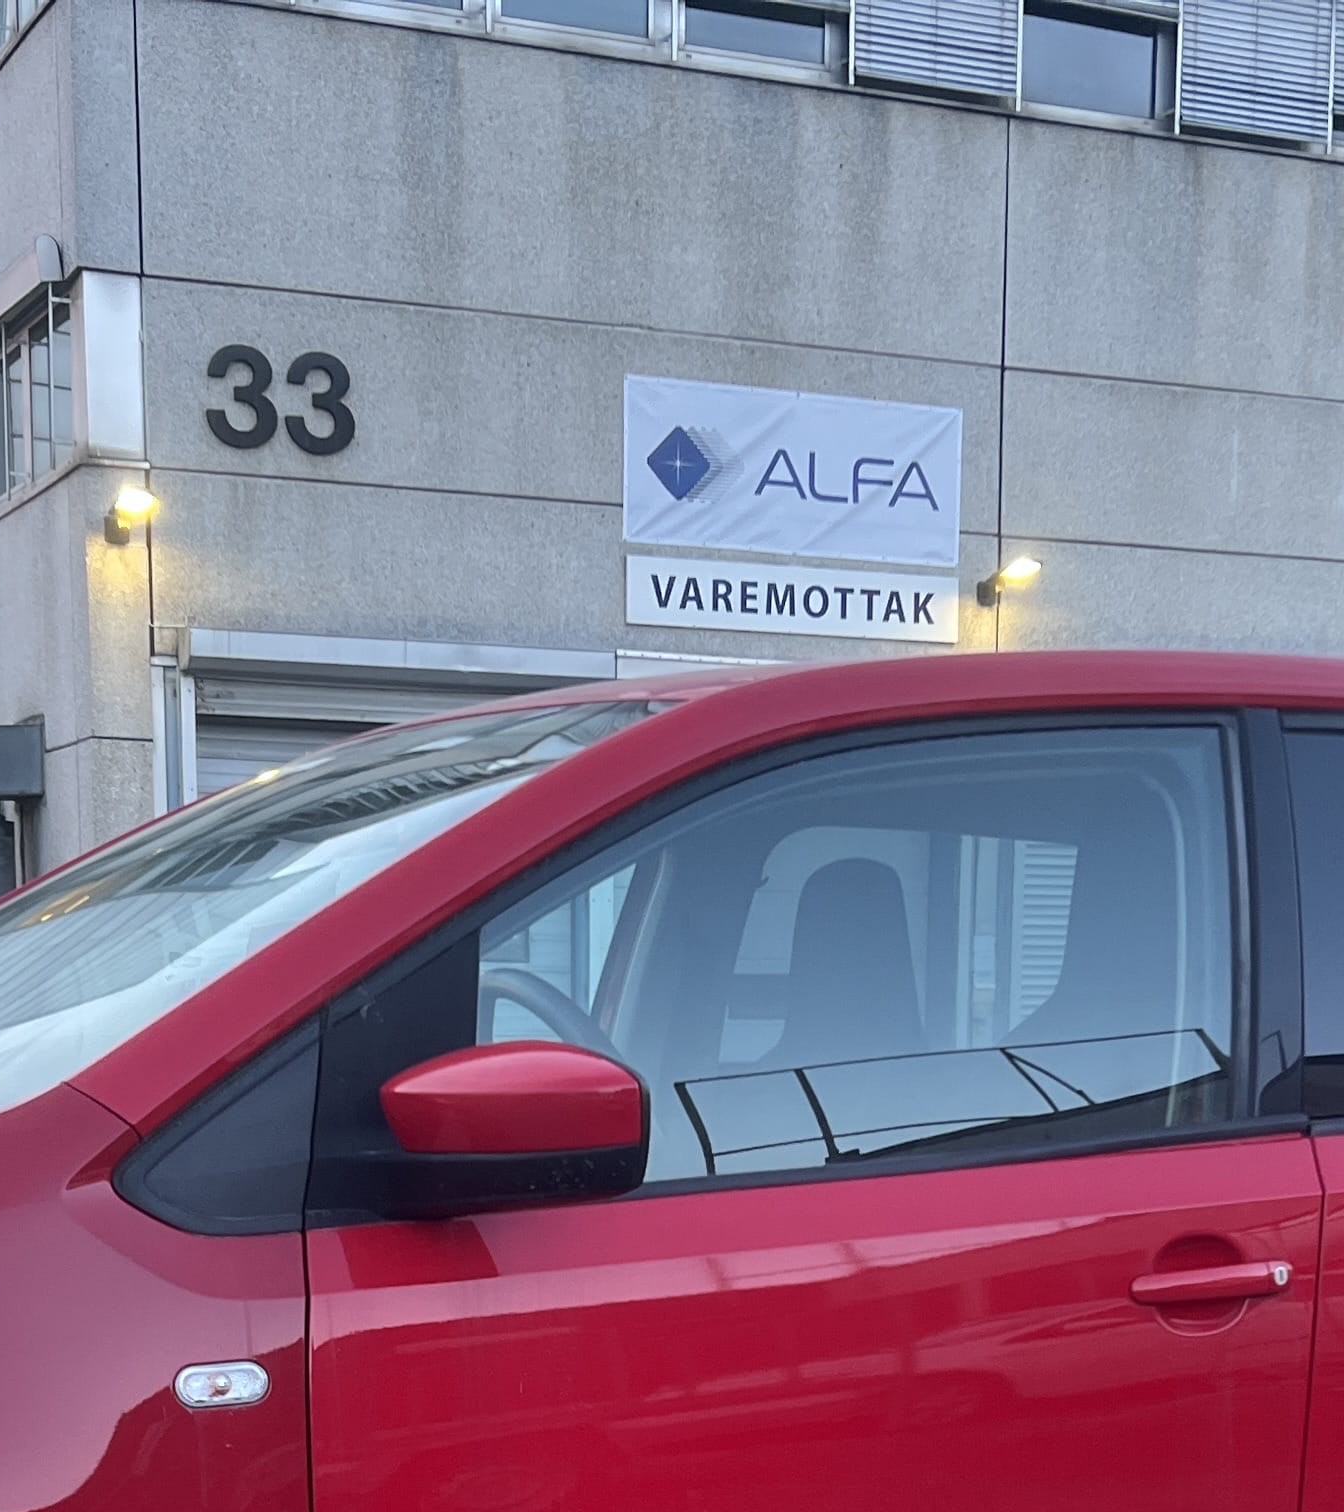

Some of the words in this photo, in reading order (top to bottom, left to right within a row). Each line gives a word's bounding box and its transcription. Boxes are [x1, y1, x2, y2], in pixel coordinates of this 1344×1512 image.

[205, 343, 356, 456] 33
[754, 448, 939, 512] ALFA
[650, 573, 935, 625] VAREMOTTAK
